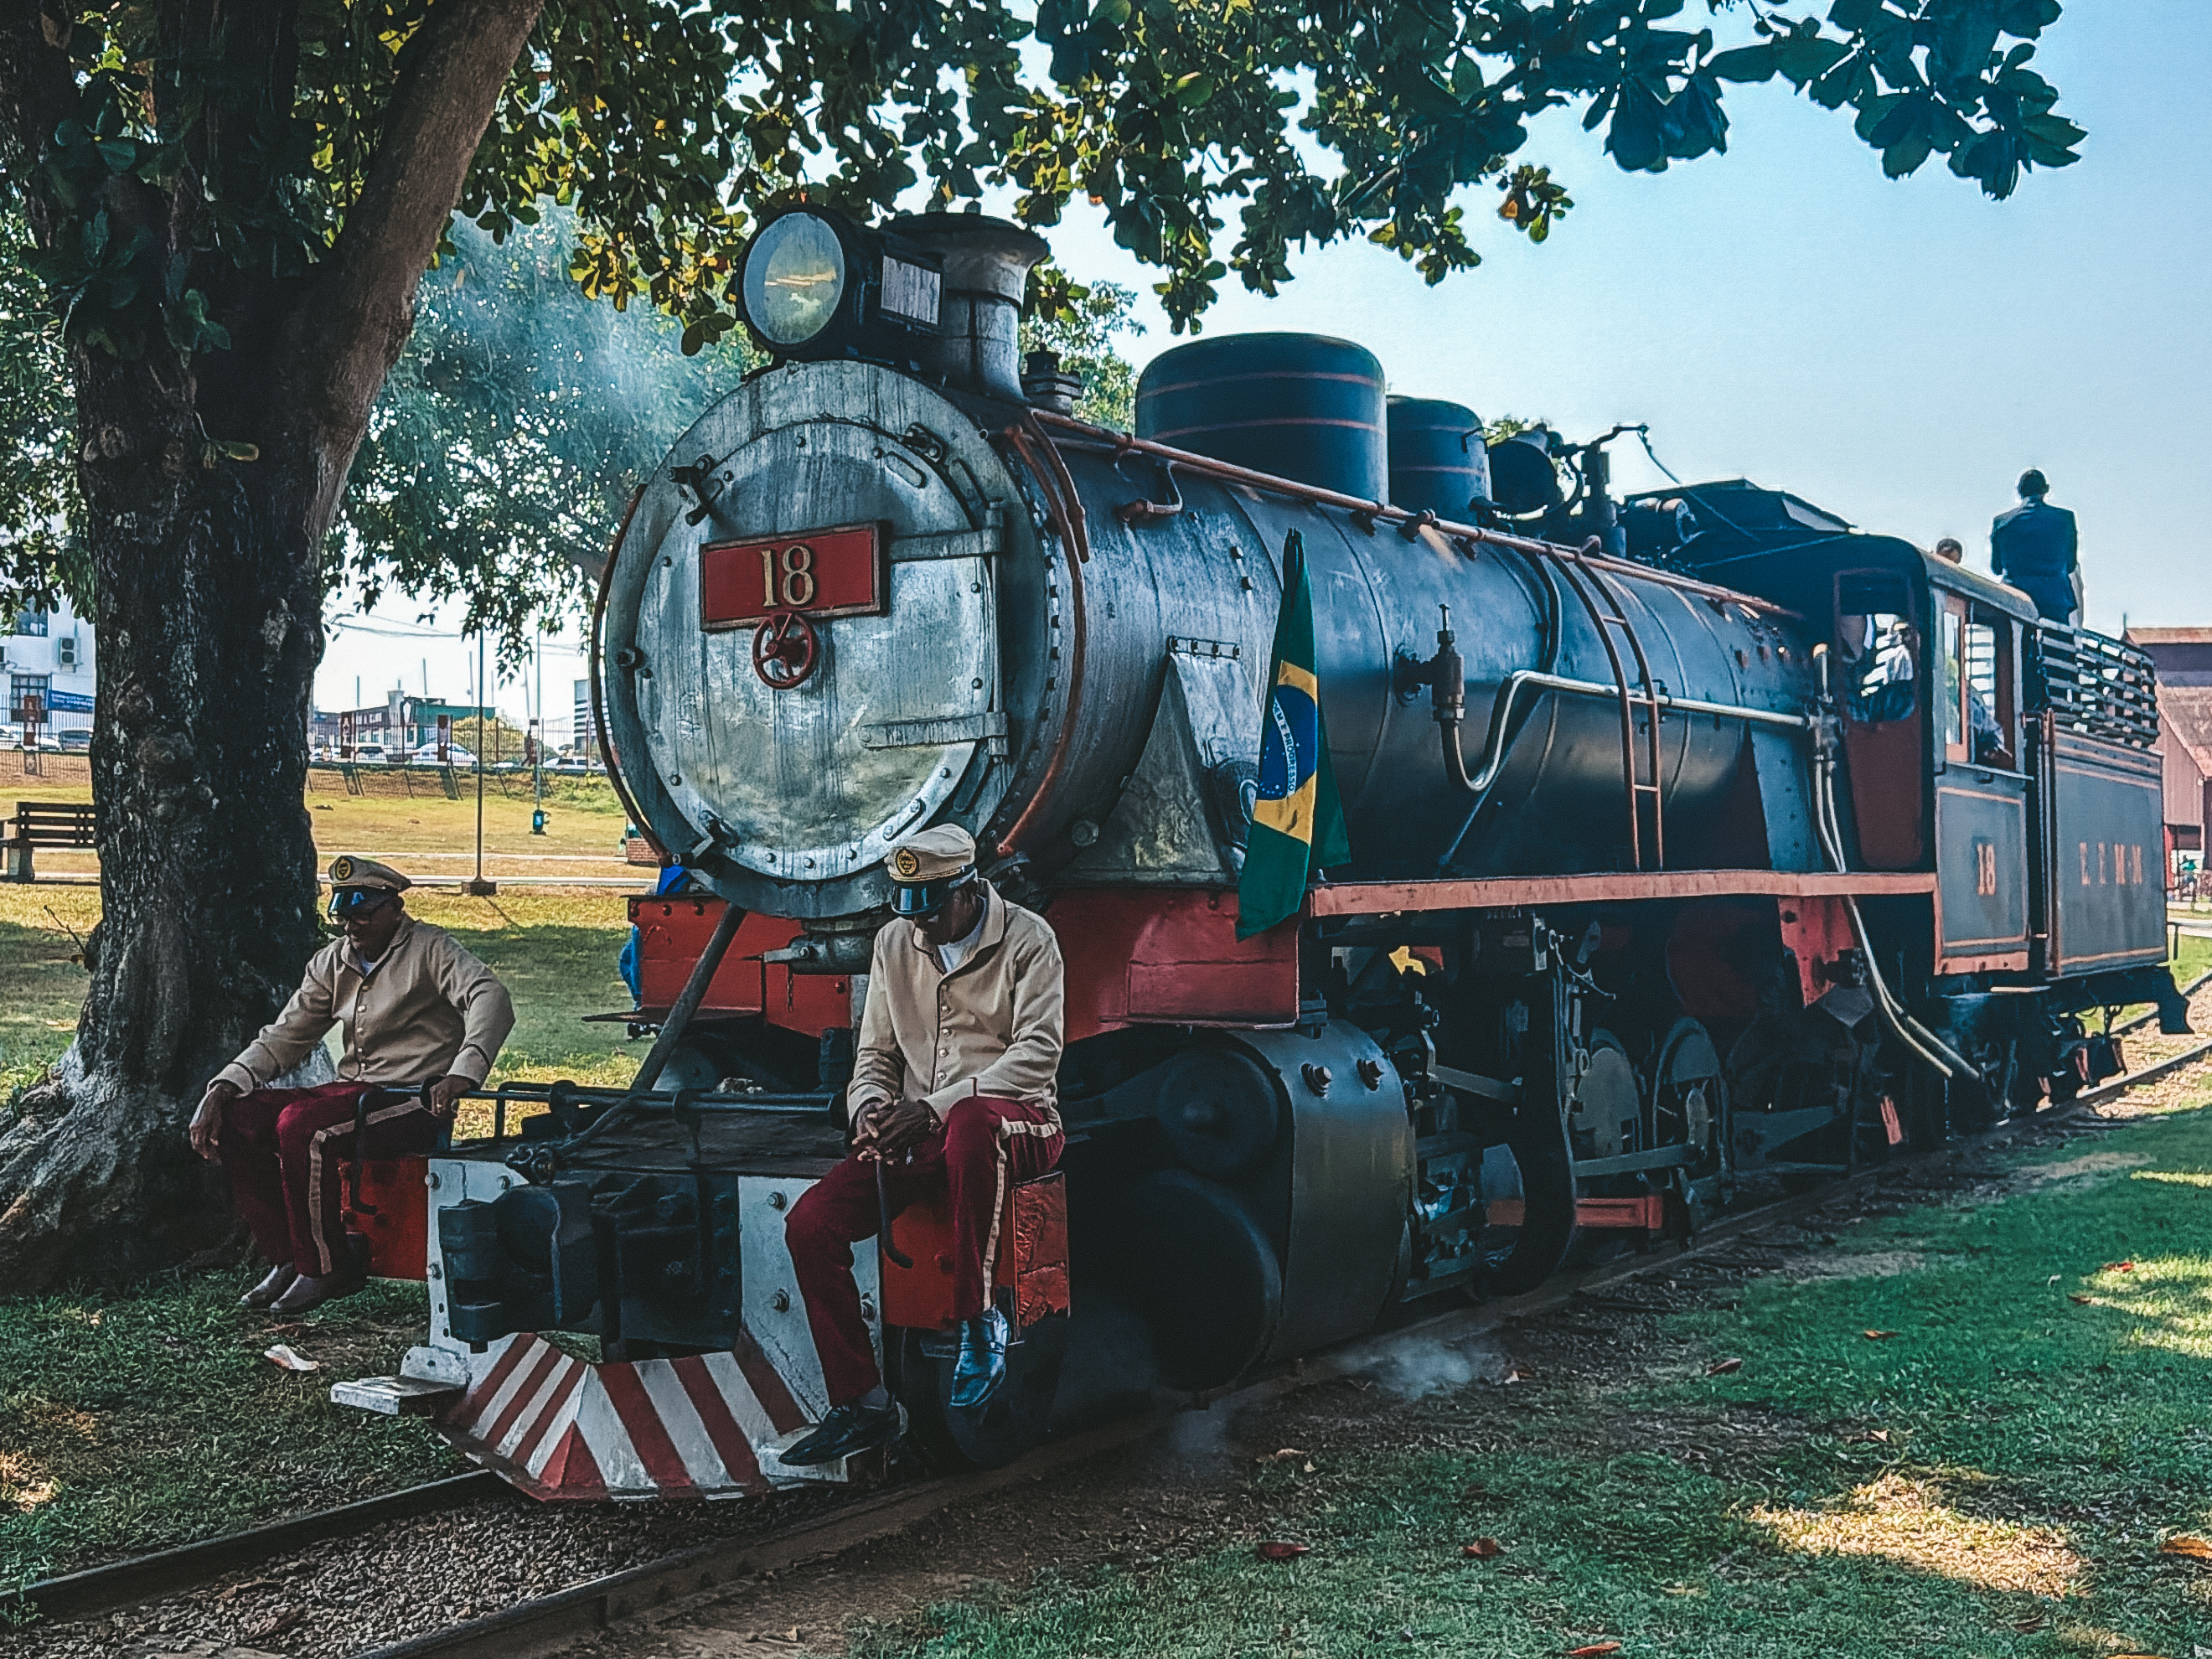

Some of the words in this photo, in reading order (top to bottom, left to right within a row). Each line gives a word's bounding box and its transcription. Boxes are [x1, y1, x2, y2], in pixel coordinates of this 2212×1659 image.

[761, 545, 814, 607] 18
[1284, 733, 1295, 791] PROGRESSO
[1977, 843, 1996, 896] 18
